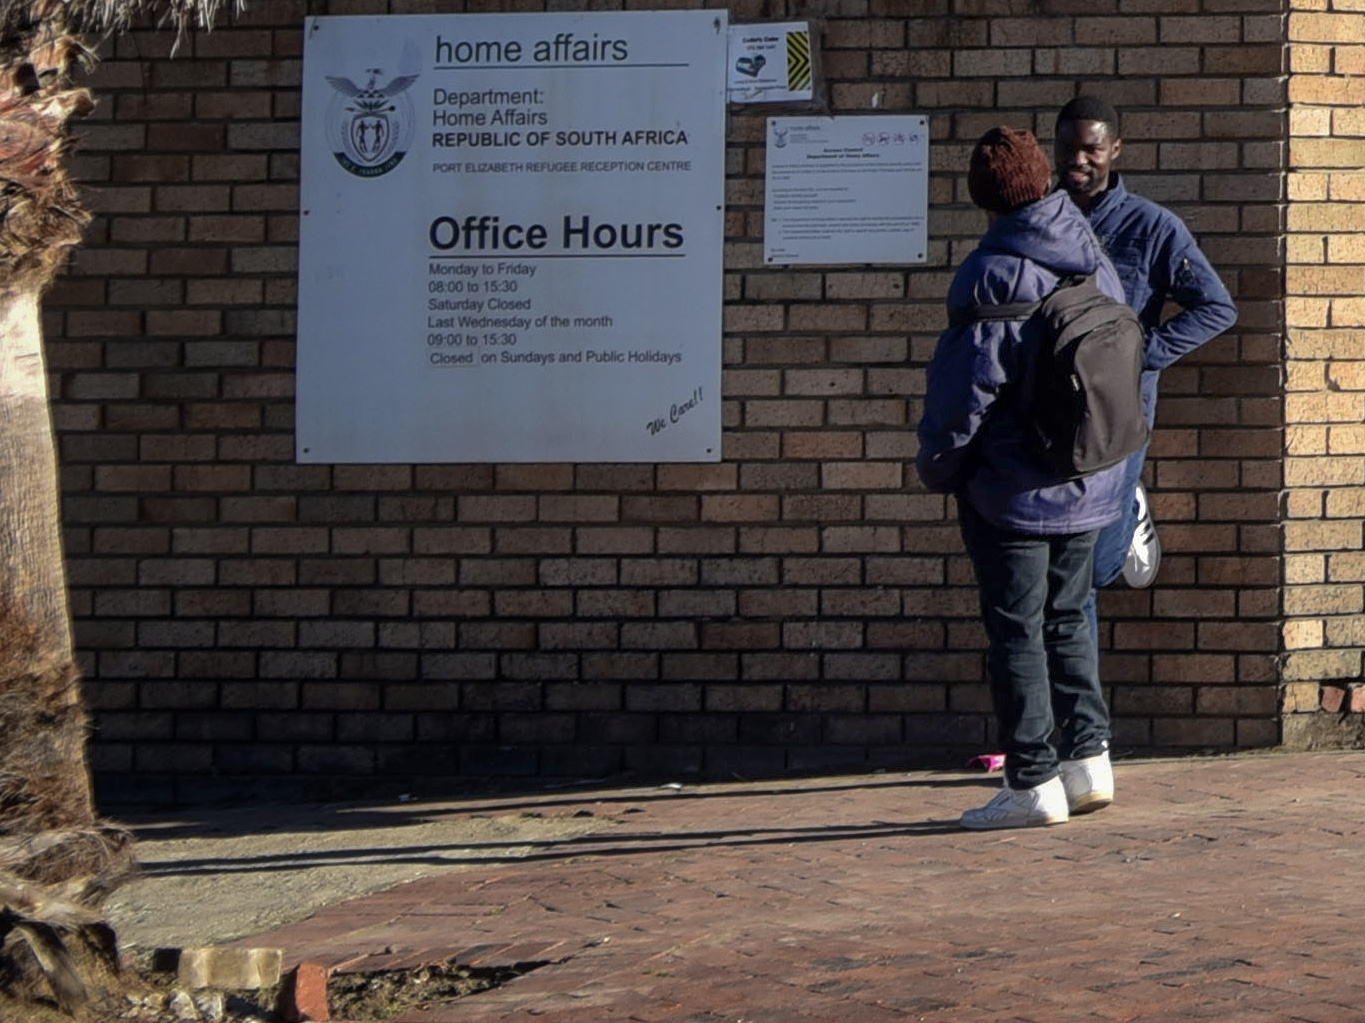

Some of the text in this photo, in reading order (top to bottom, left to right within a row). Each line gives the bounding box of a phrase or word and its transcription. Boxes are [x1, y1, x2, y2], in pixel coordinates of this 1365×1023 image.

[436, 33, 627, 63] home affairs
[433, 88, 543, 108] Department:
[433, 109, 547, 126] Home Affairs
[432, 130, 688, 147] REPUBLIC OF SOUTH AFRICA
[433, 161, 691, 173] PORT ELIZABETH REFUGEE RECEPTION CENTRE
[430, 216, 683, 250] Office Hours
[429, 262, 536, 278] Monday to Friday
[428, 280, 518, 293] 08:00 to 15:30
[428, 298, 531, 314] Saturday Closed
[428, 315, 612, 332] Last Wednesday of the month
[427, 333, 517, 346] 09:00 to 15:30
[430, 350, 682, 366] Closed on Sundays and Public Holidays
[646, 418, 666, 436] We
